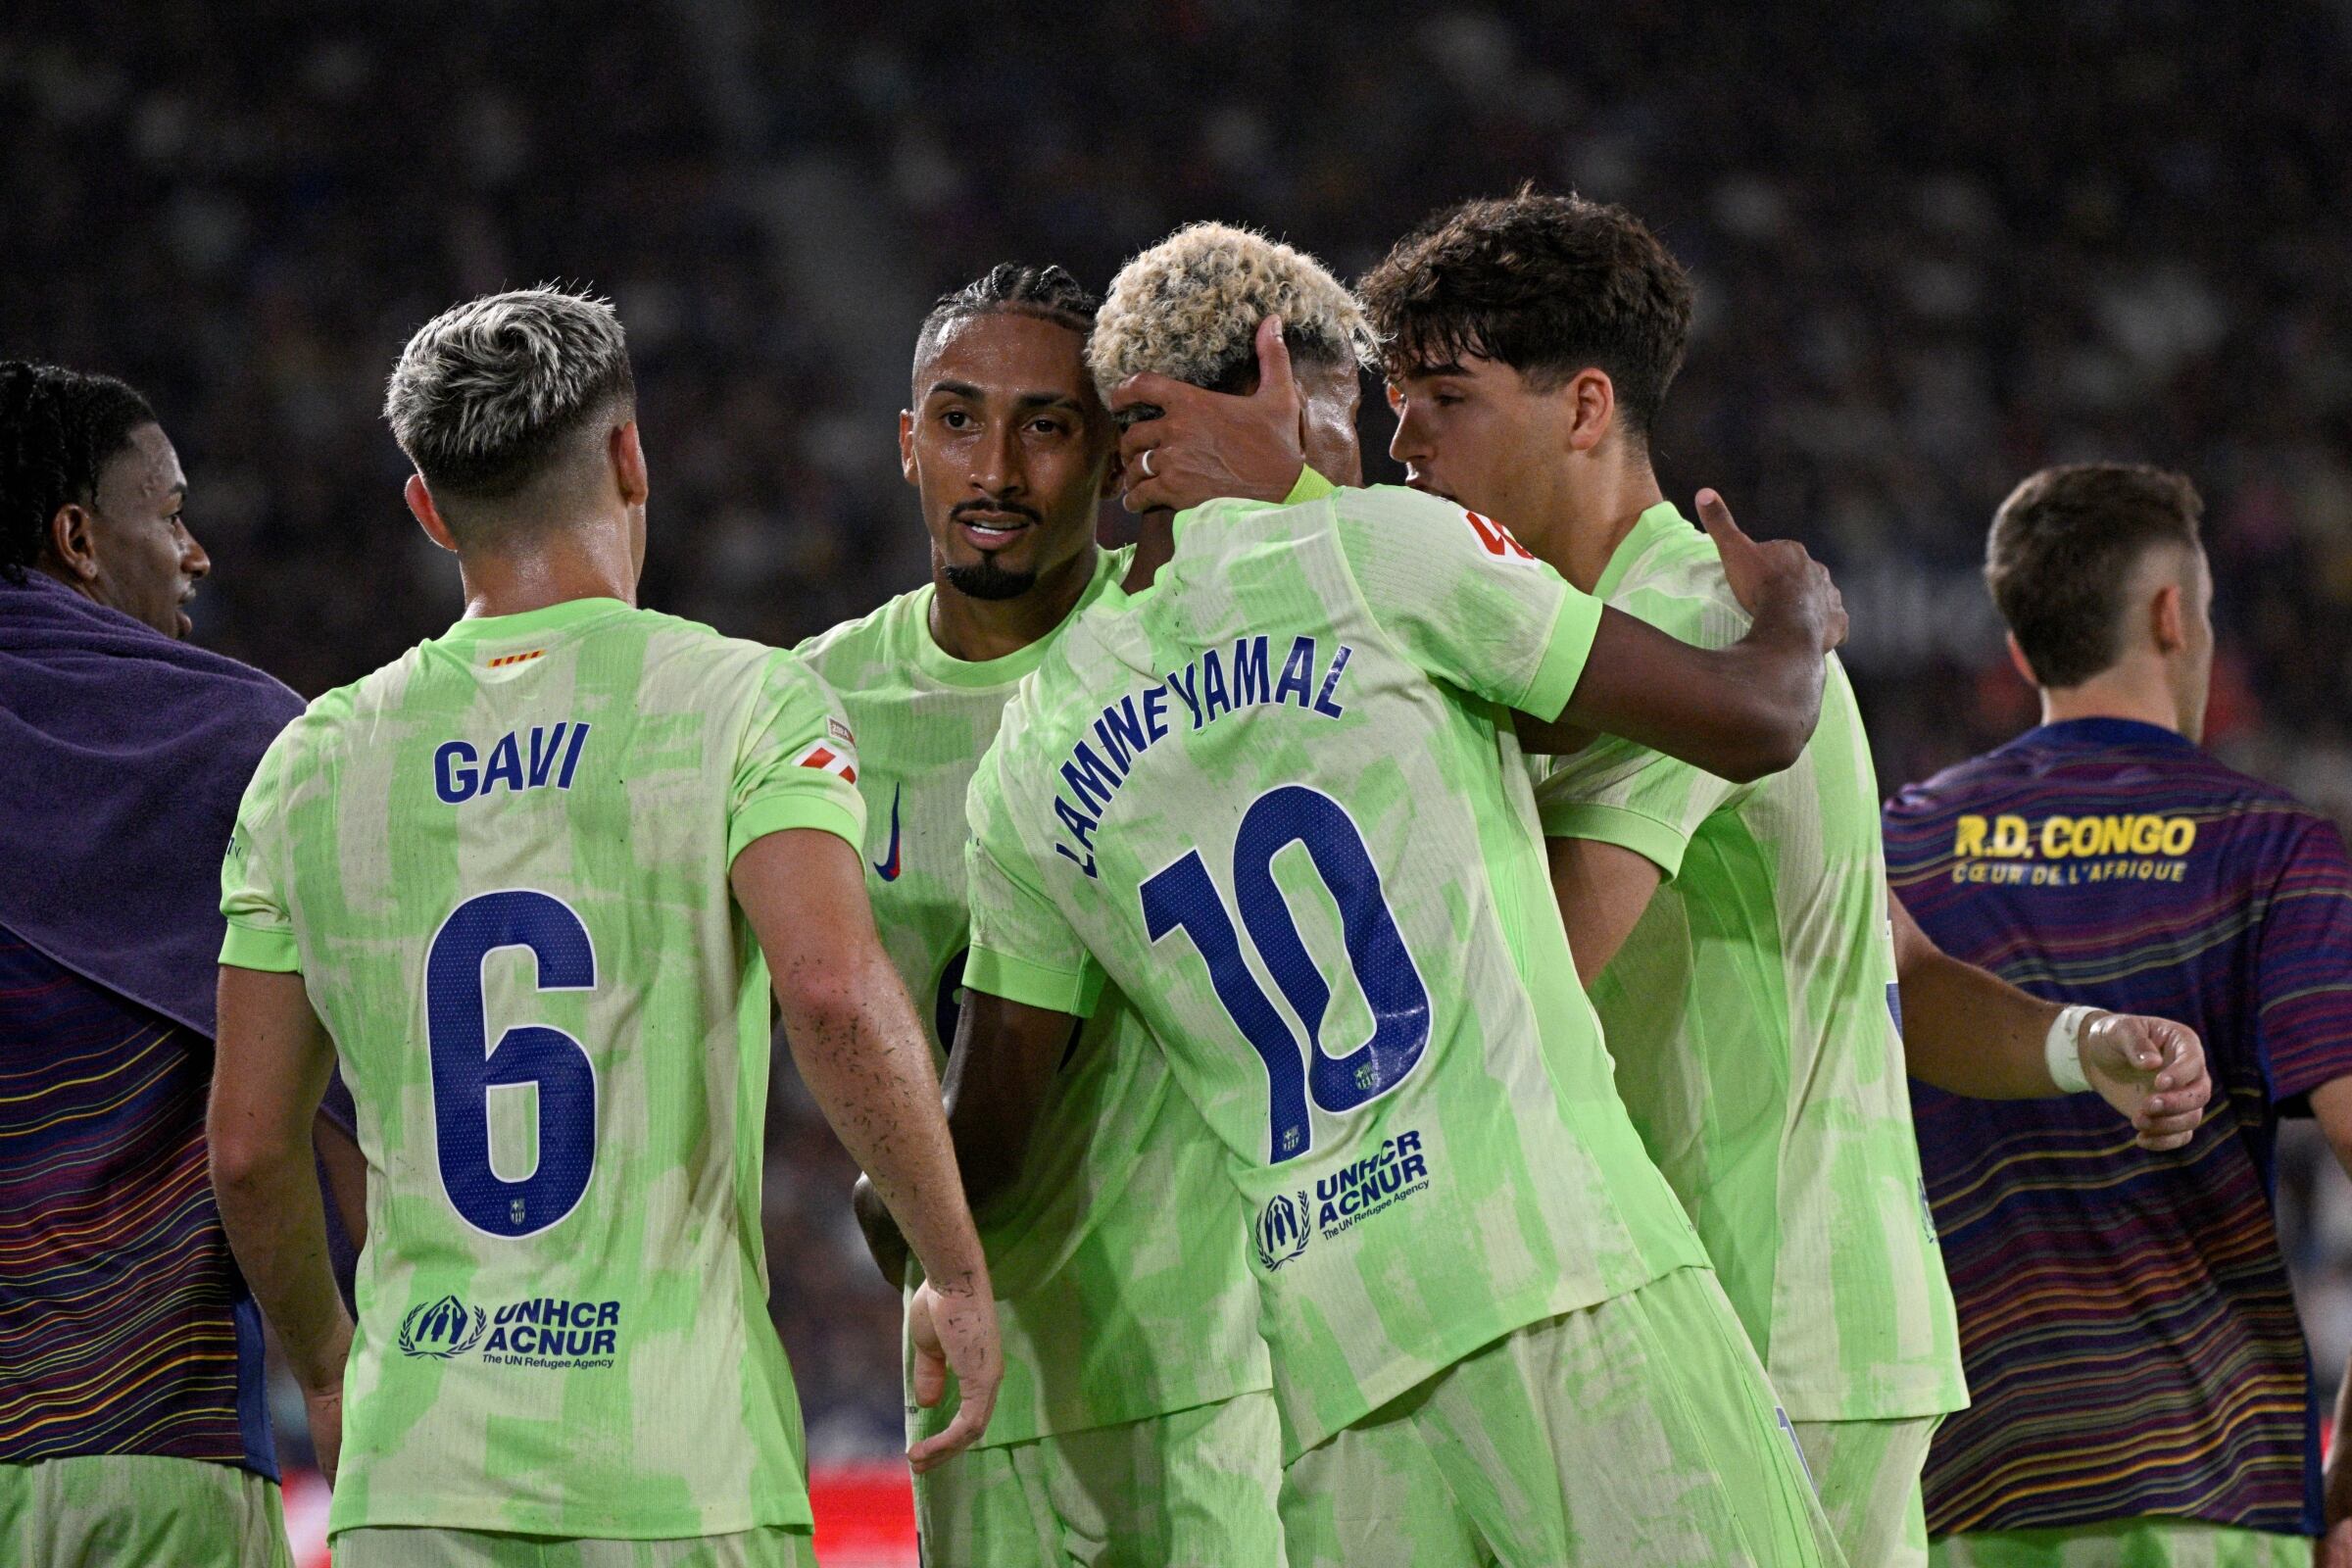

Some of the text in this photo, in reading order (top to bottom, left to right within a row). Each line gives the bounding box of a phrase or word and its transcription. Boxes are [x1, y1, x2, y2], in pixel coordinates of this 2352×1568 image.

[433, 721, 591, 806] GAVI
[1054, 634, 1353, 879] LAMINE YAMAL
[1954, 814, 2197, 859] R.D. CONGO
[2068, 859, 2187, 885] L'AFRIQUE
[1138, 783, 1434, 1166] 10
[424, 888, 598, 1241] 6
[1316, 1130, 1422, 1201] UNHCR
[1319, 1153, 1428, 1230] ACNUR
[1322, 1180, 1430, 1241] The UN Refugee Agency
[483, 1326, 616, 1356] ACNUR
[493, 1298, 620, 1328] UNHCR
[482, 1353, 614, 1370] The UN Refugee Agency
